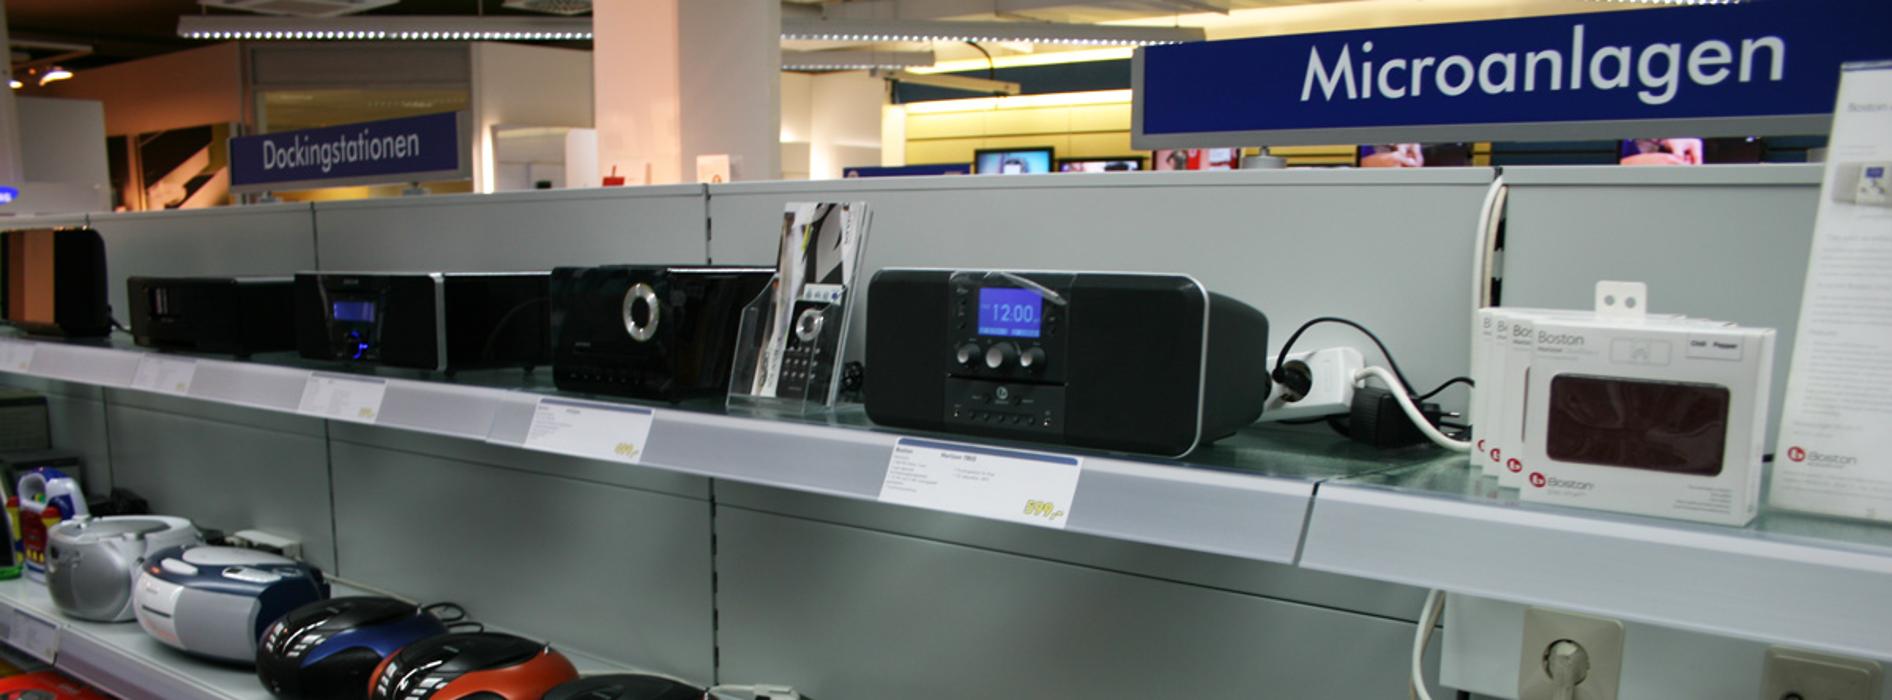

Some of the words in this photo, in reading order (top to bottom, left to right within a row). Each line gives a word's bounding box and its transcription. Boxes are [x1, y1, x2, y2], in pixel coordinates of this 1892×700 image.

[1300, 24, 1786, 105] Microanlagen
[262, 127, 420, 173] Dockingstationen
[992, 303, 1034, 323] 12:00
[1537, 330, 1585, 346] Boston
[1808, 451, 1857, 465] Boston
[1548, 477, 1594, 490] Boston
